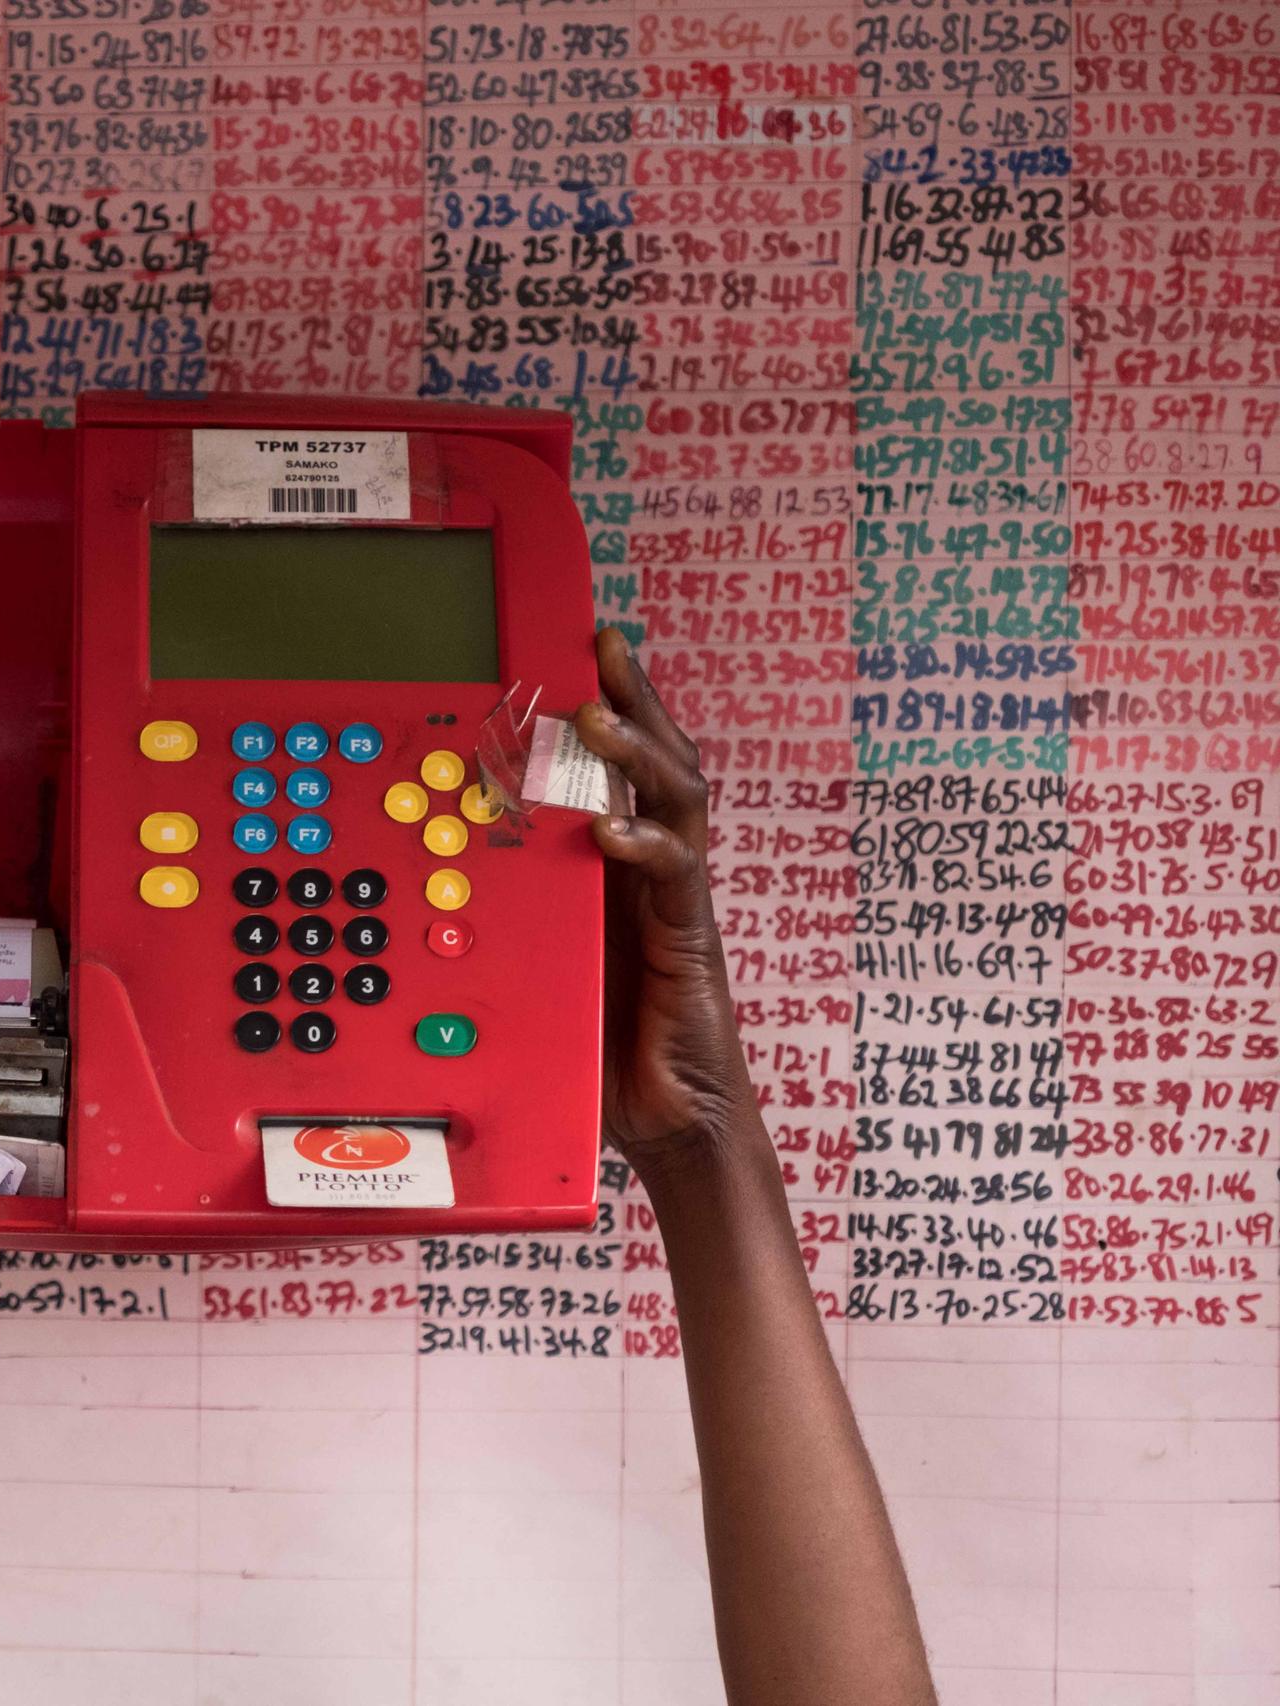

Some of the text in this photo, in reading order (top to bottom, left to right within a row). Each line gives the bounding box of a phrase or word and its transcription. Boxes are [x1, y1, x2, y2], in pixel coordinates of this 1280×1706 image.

[255, 440, 367, 454] TPM 52737
[286, 459, 338, 469] SAMAKO
[244, 737, 262, 749] F1
[297, 737, 317, 749] F2
[351, 739, 371, 751] F3
[244, 783, 264, 795] F4
[299, 783, 319, 795] F5
[245, 829, 265, 841] F6
[300, 829, 320, 841] F7
[249, 880, 261, 895] 7
[305, 883, 316, 897] 8
[359, 883, 370, 898] 9
[443, 884, 455, 897] A
[250, 928, 262, 943] 4
[306, 930, 318, 945] 5
[361, 930, 372, 944] 6
[443, 930, 457, 944] C
[254, 976, 260, 991] 1
[307, 978, 319, 993] 2
[362, 978, 373, 993] 3
[308, 1026, 320, 1041] 0
[440, 1028, 454, 1043] V
[1070, 1075, 1104, 1105] 73
[1203, 1080, 1232, 1109] 10
[855, 1117, 893, 1152] 35
[903, 1120, 939, 1159] 41
[946, 1121, 983, 1160] 79
[994, 1123, 1022, 1159] 81
[298, 1172, 413, 1183] PREMIER
[315, 1183, 402, 1191] LOTTO
